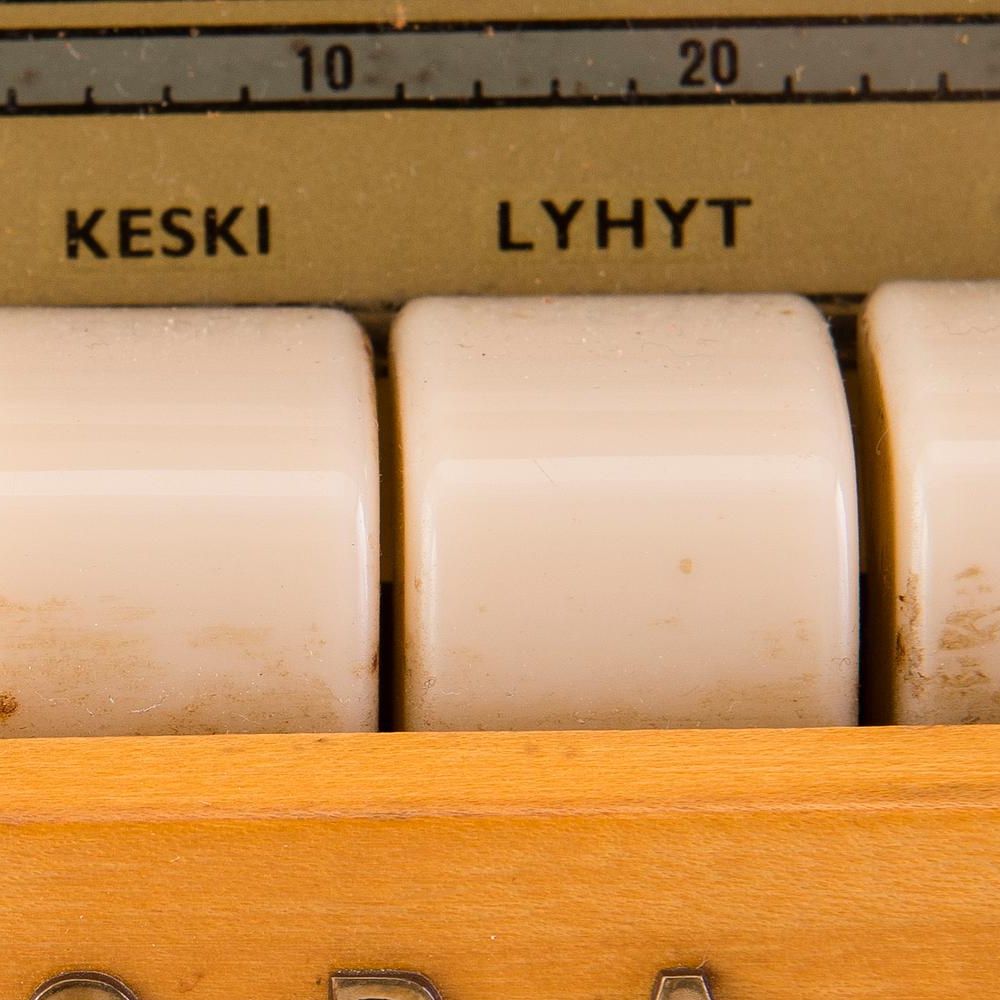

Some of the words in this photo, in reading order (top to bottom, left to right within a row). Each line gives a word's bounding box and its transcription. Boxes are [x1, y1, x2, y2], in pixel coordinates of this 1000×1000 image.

[297, 44, 354, 92] 10
[679, 39, 739, 87] 20
[66, 204, 271, 259] KESKI
[497, 199, 752, 252] LYHYT
